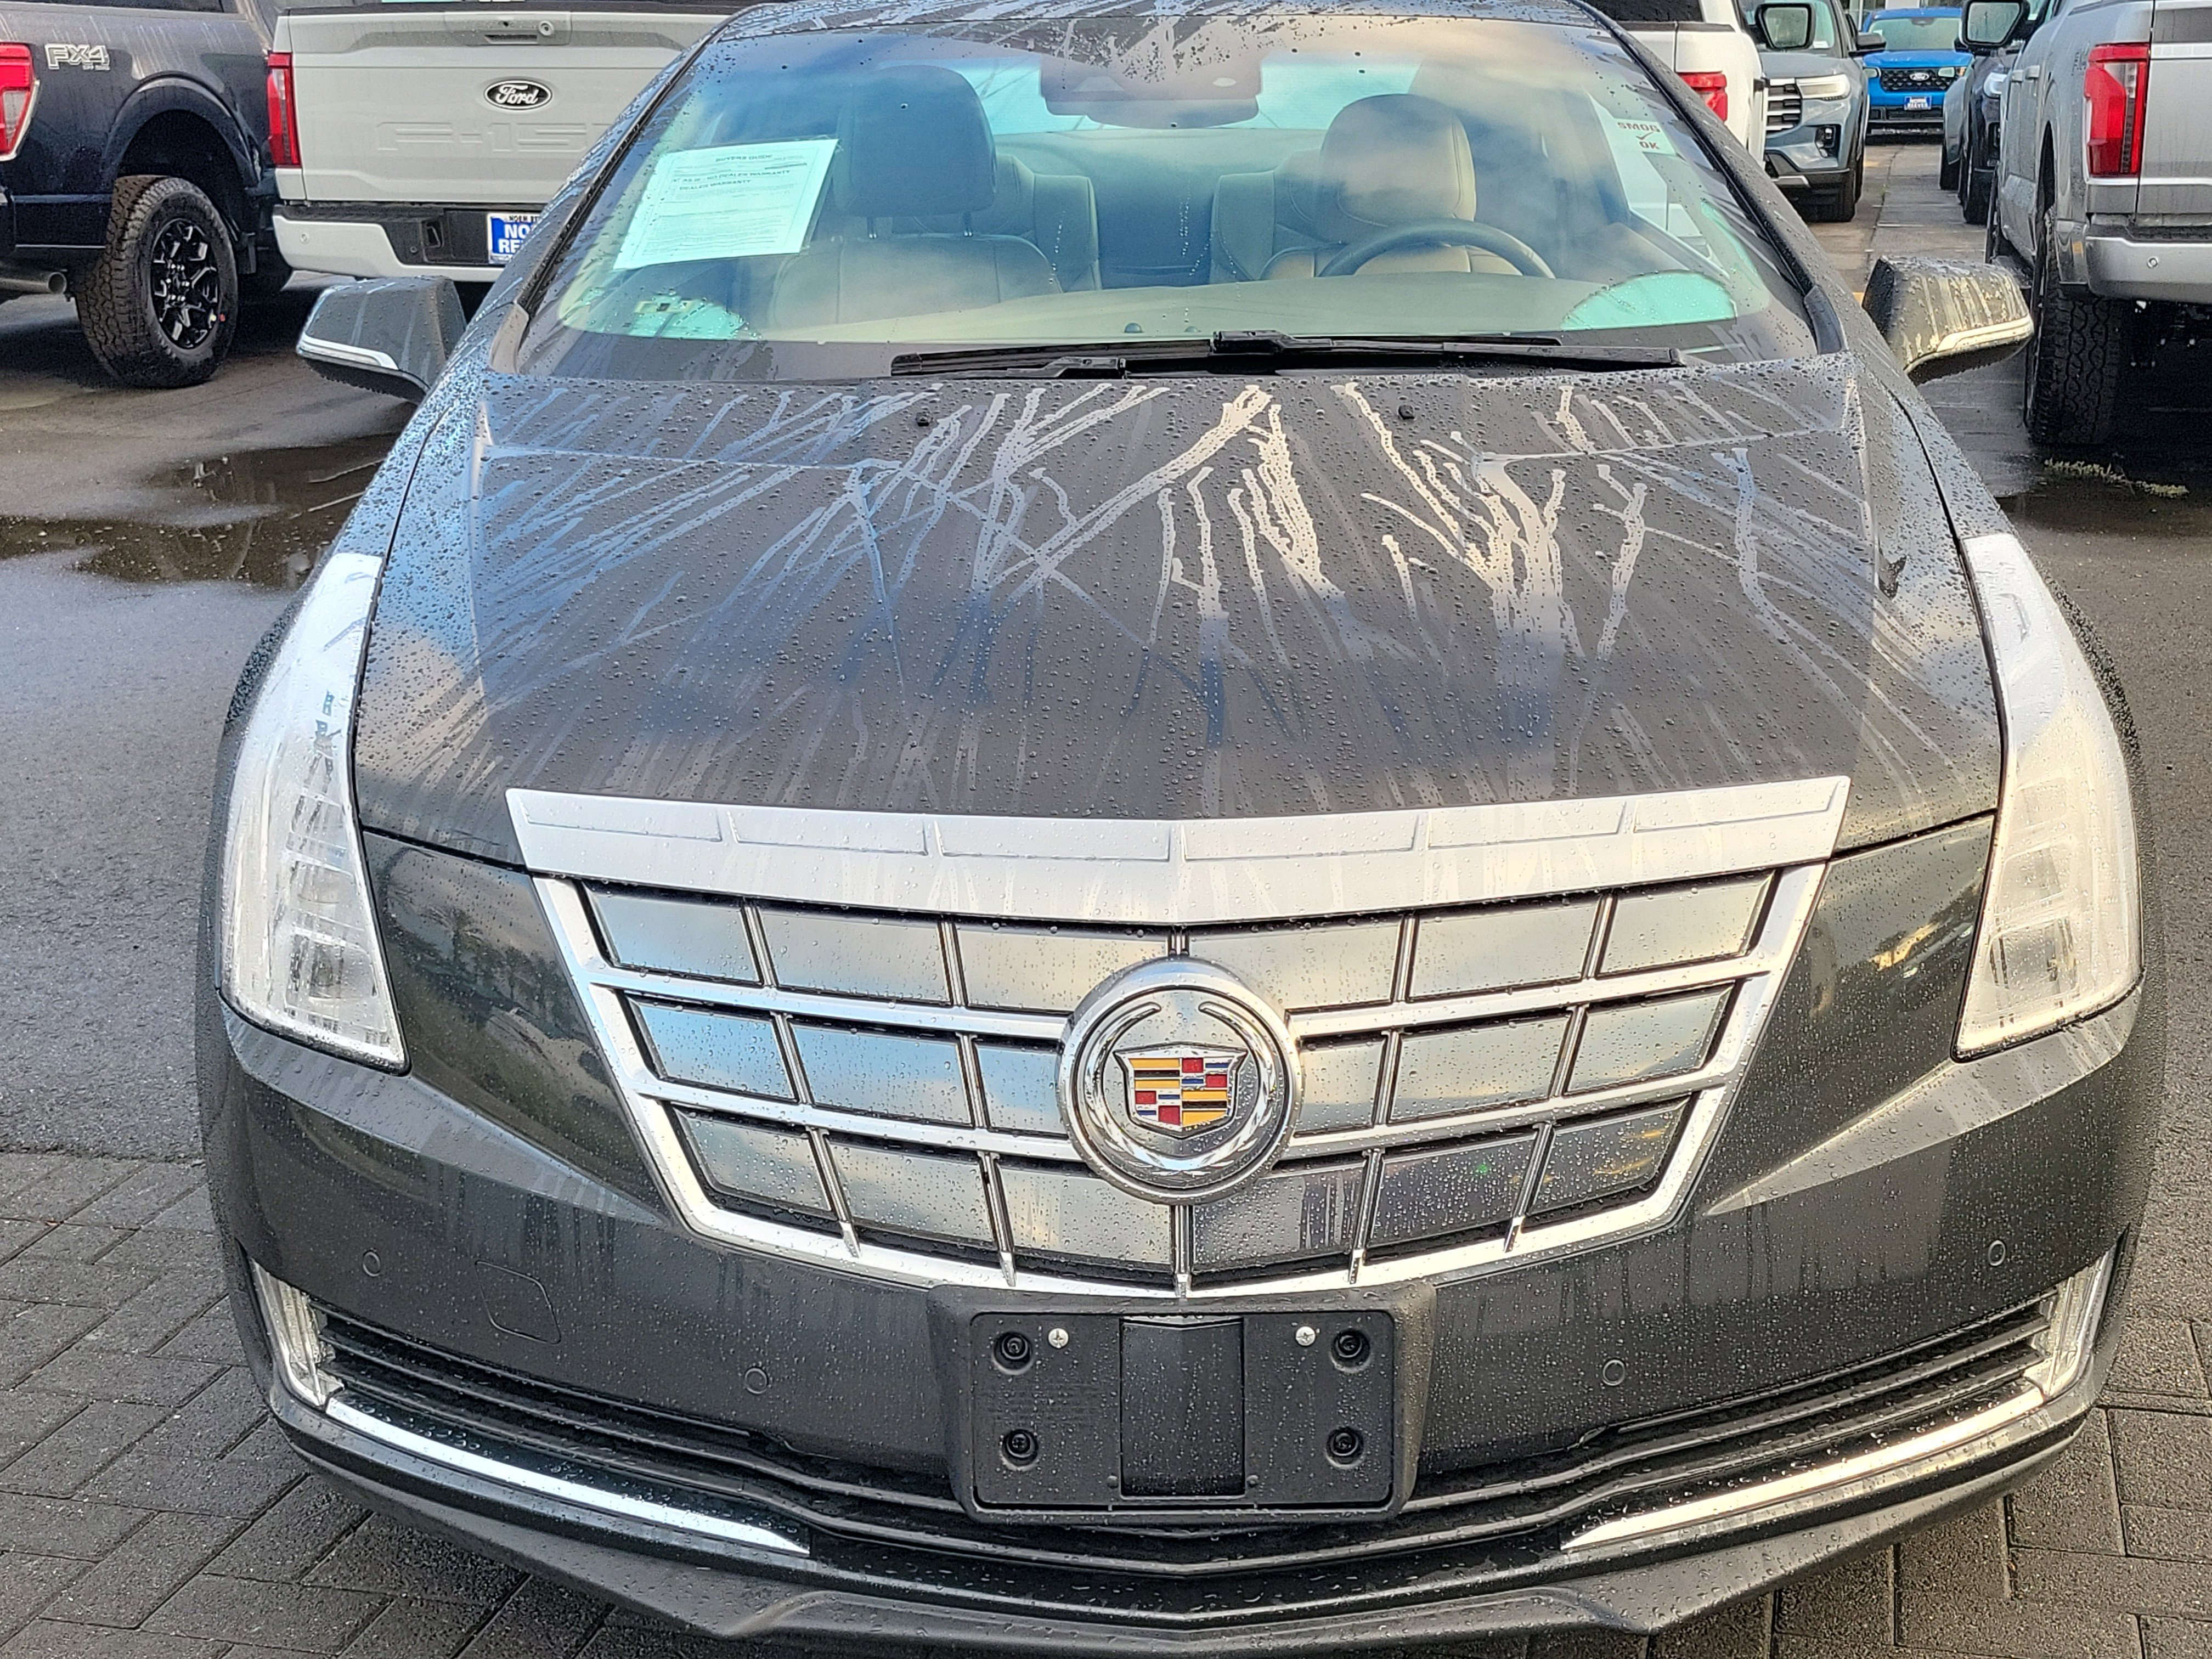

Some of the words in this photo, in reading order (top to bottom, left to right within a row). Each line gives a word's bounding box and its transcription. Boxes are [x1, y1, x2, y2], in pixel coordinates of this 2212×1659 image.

[44, 43, 110, 70] FX4
[495, 84, 539, 104] Ford
[376, 121, 611, 153] F-15
